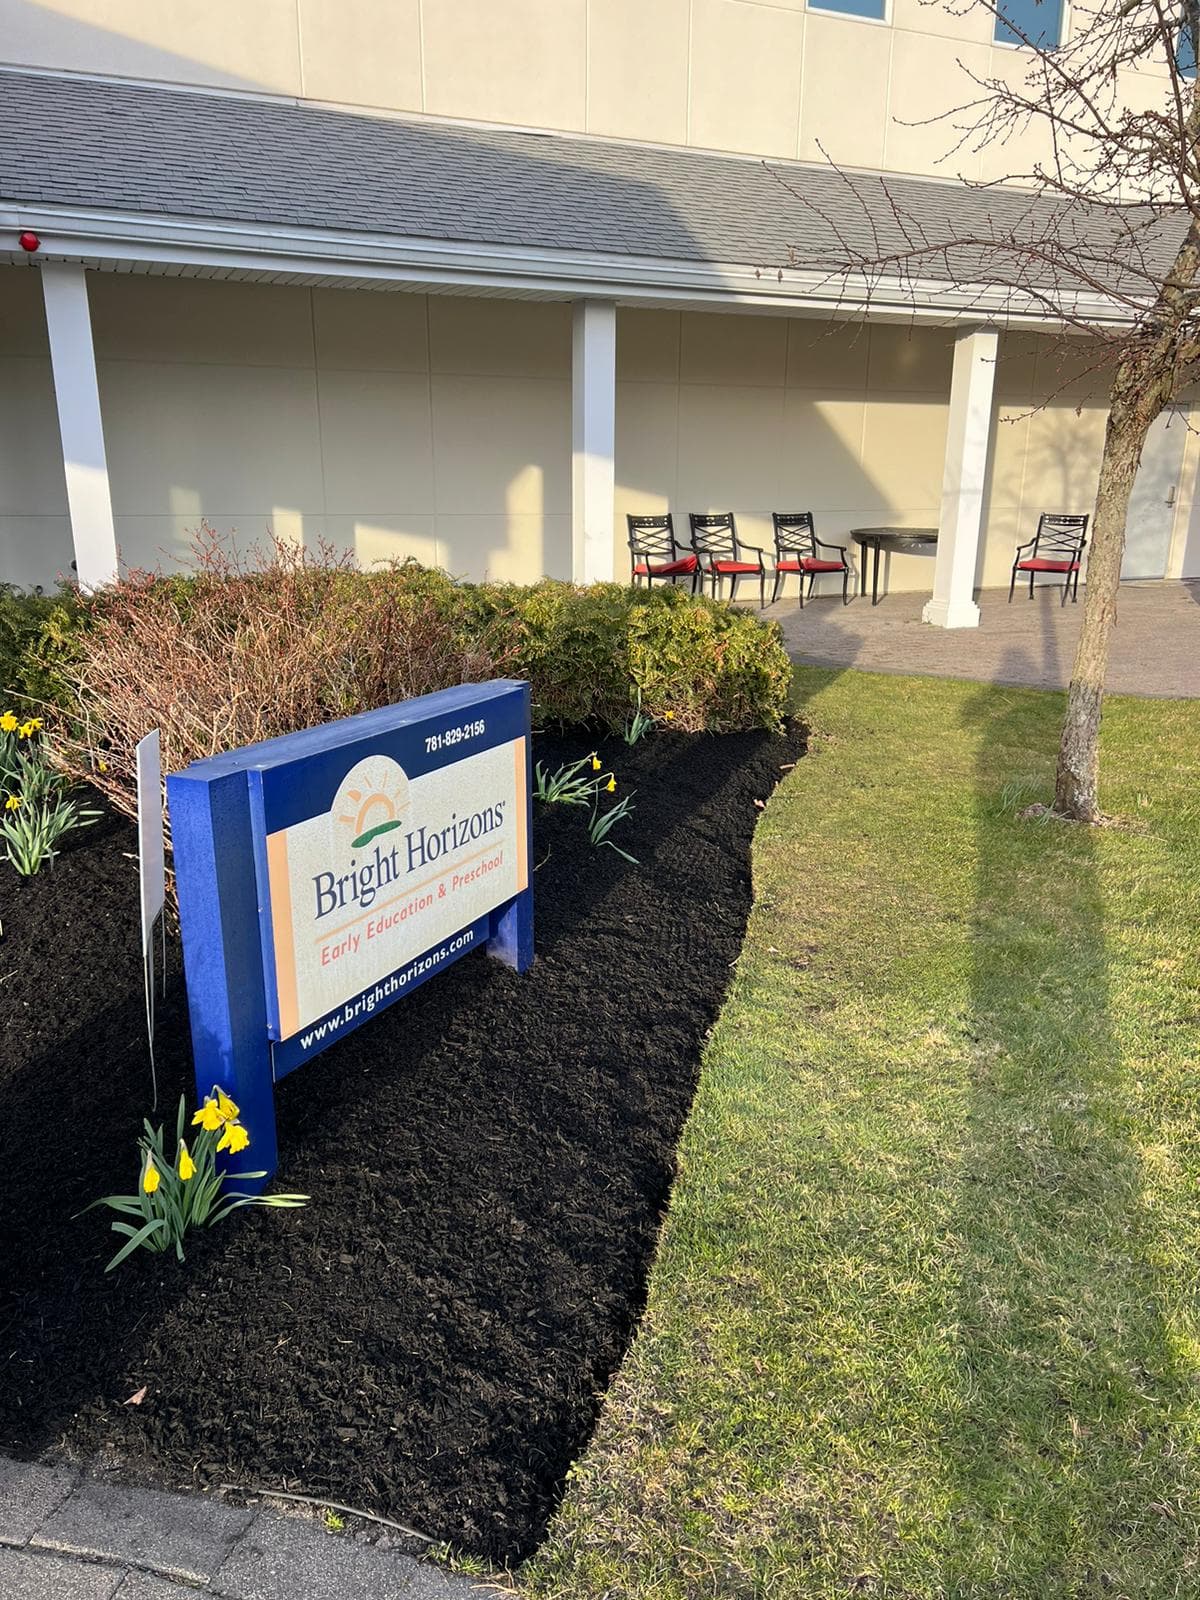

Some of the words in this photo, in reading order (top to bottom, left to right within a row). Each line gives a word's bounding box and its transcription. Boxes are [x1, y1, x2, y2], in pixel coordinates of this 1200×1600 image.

[425, 720, 485, 753] 781-829-2156
[312, 842, 400, 920] Bright
[320, 933, 360, 966] Early
[366, 893, 433, 940] Education
[438, 883, 447, 898] &
[452, 850, 504, 891] Preschool
[299, 929, 474, 1050] www.brighthorizons.com
